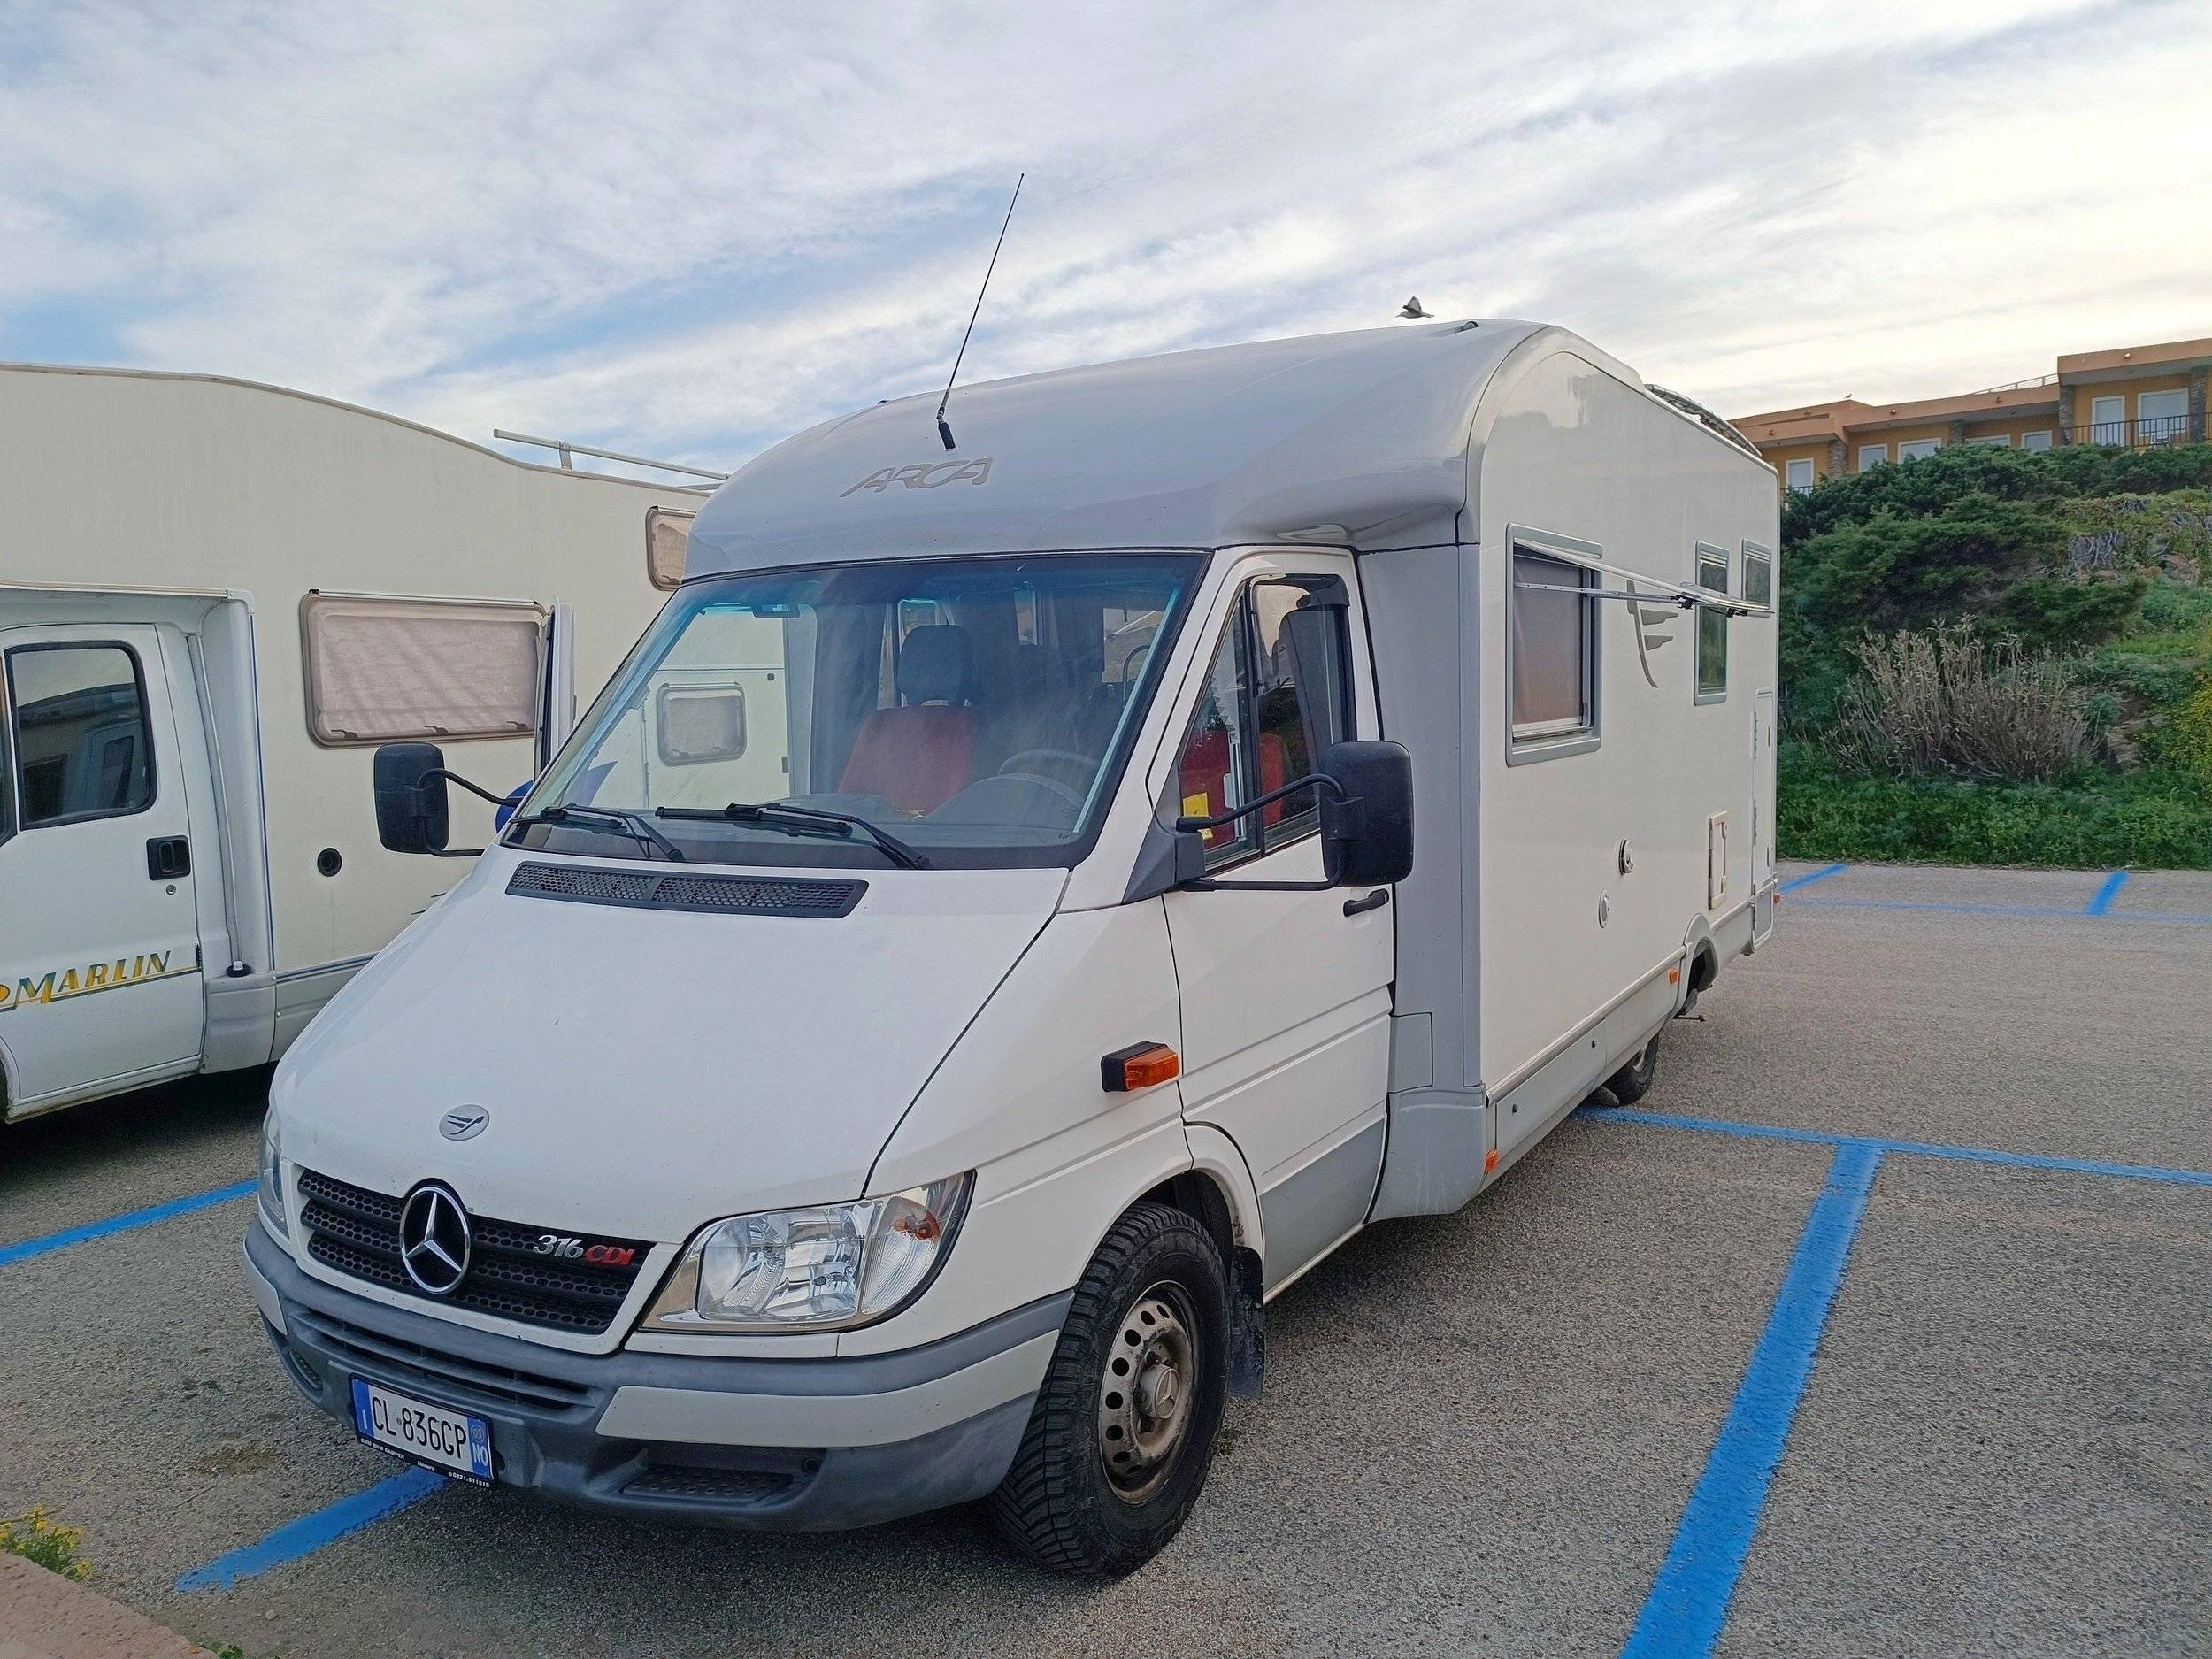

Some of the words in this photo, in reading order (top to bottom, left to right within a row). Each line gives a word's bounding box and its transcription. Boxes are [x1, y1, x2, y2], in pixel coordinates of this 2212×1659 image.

[840, 457, 994, 497] ARCA
[14, 950, 171, 1007] MARLIN
[533, 1234, 584, 1258] 316
[584, 1244, 636, 1265] CDI
[372, 1396, 397, 1437] CL
[401, 1407, 467, 1459] 836GP
[472, 1442, 488, 1467] NO
